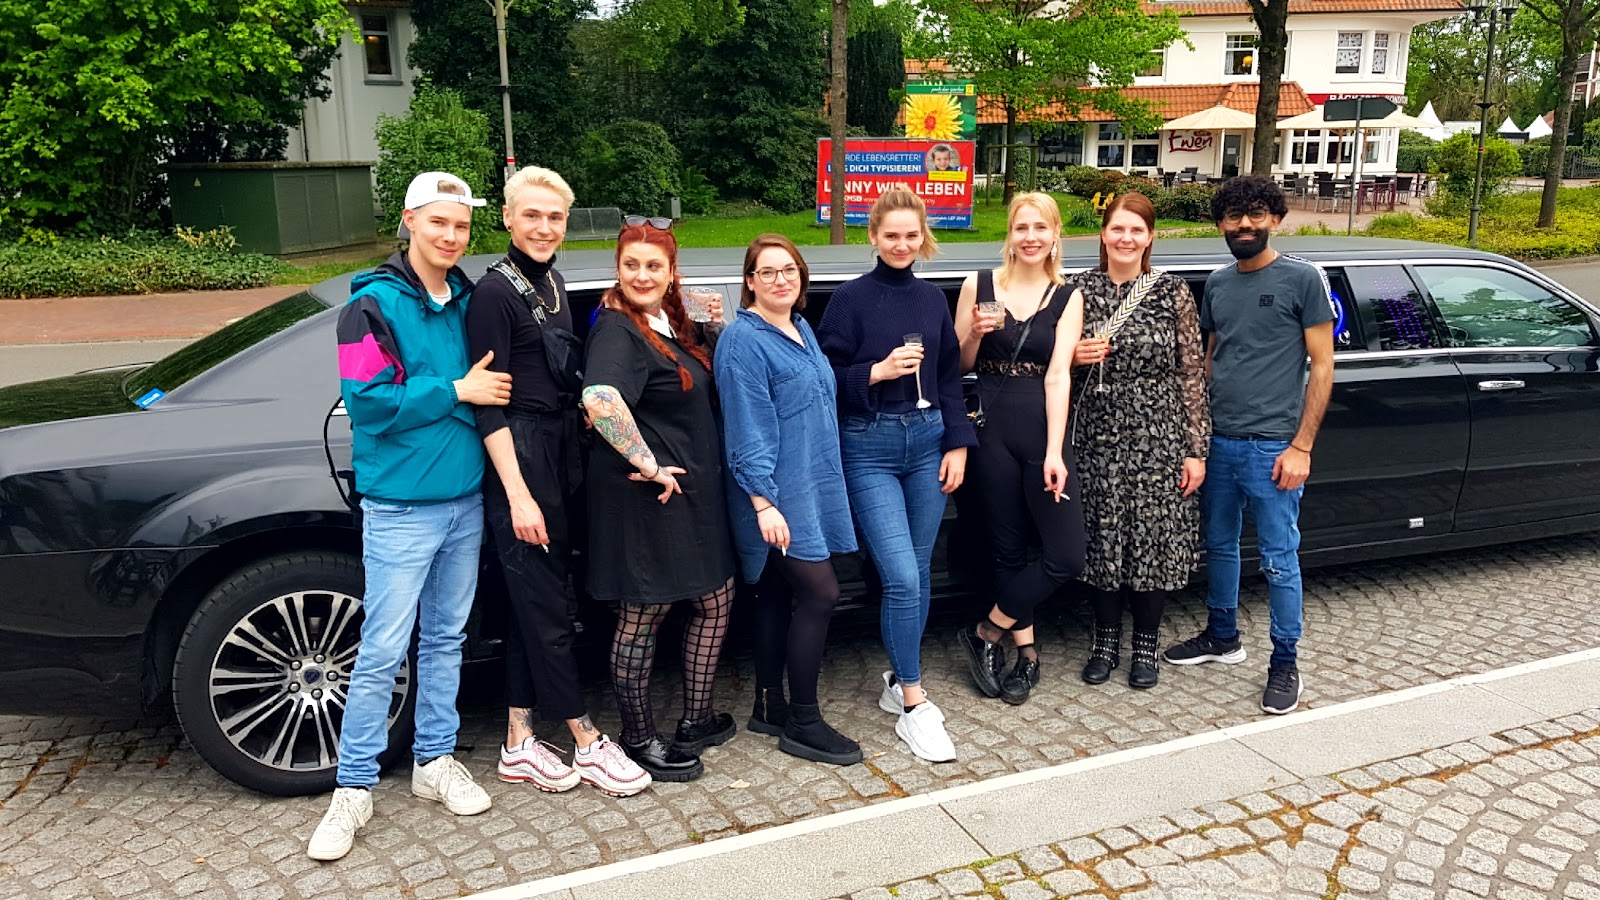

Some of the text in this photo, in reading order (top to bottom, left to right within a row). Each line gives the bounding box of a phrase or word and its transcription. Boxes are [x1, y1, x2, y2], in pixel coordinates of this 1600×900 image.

[1168, 129, 1213, 153] Ewen
[845, 154, 921, 162] RDE LEBENSRETTER!
[828, 164, 922, 172] LS DICH TYPISIEREN!
[824, 180, 965, 196] LNNY WI LEBEN
